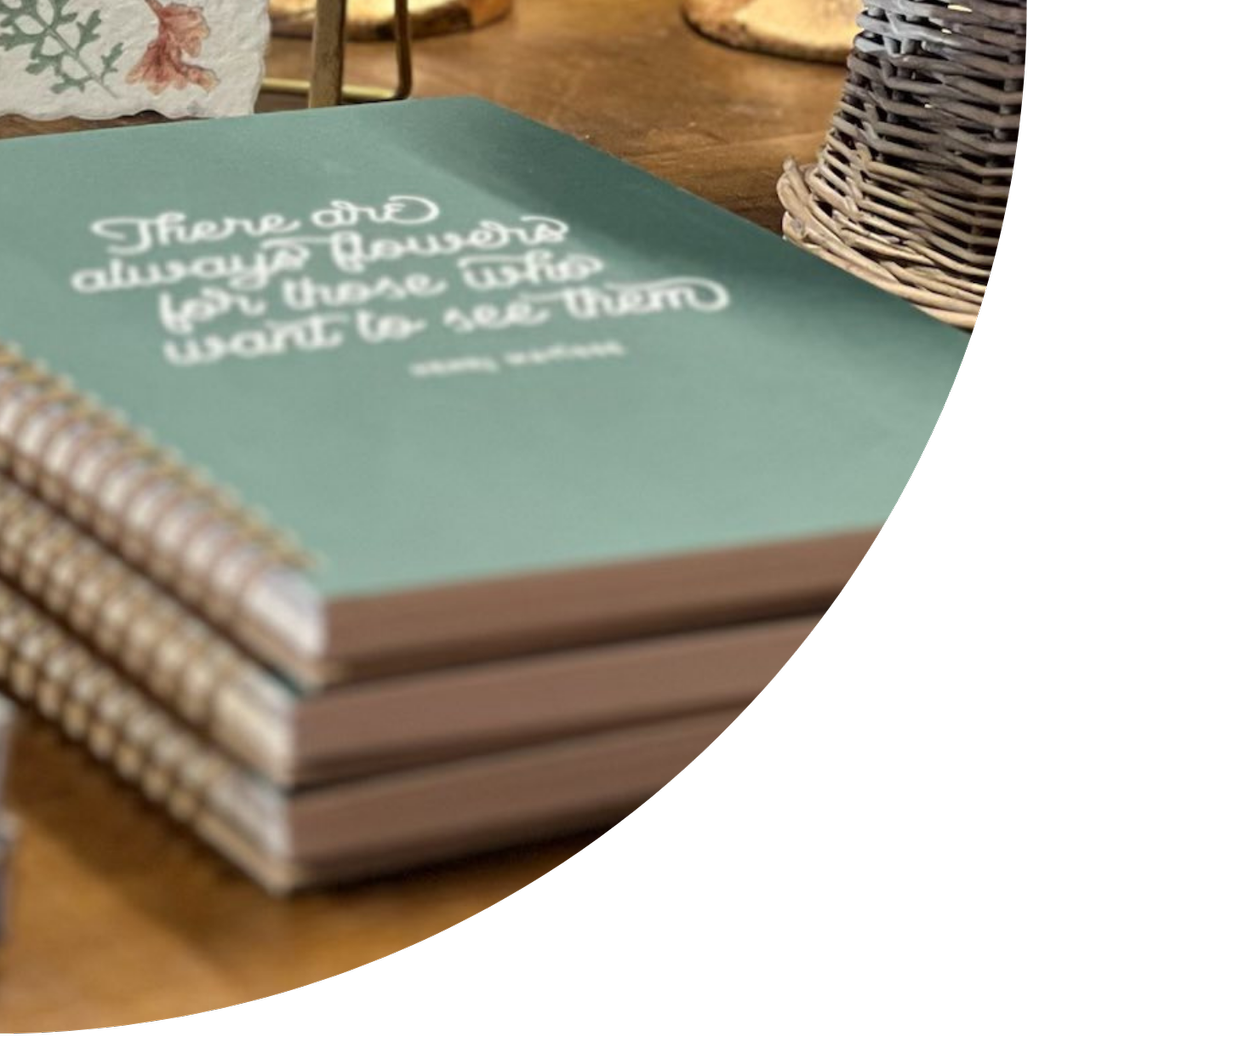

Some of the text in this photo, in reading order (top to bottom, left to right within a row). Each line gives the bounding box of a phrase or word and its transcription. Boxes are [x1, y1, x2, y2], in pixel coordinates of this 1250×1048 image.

[70, 216, 569, 292] always flowers
[90, 195, 440, 256] There are
[159, 249, 604, 335] for those who
[162, 276, 729, 368] want to see them
